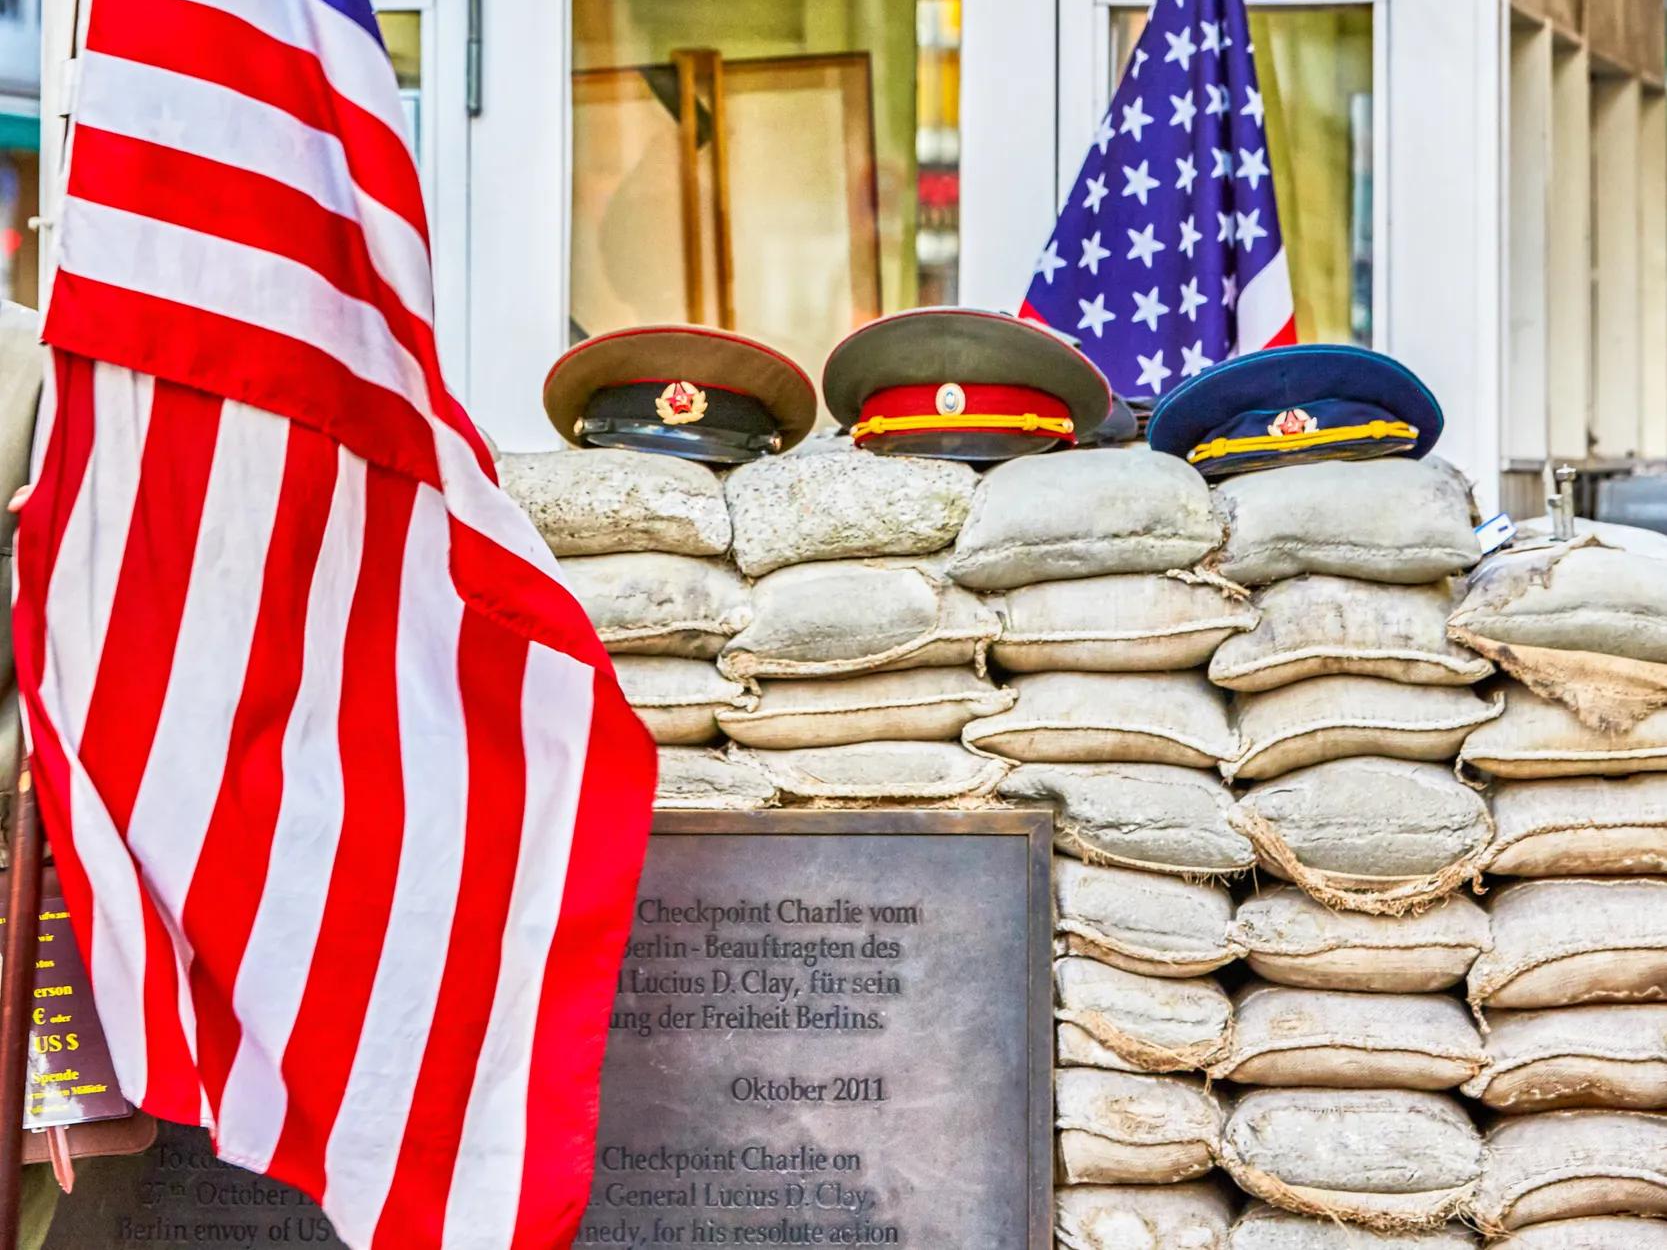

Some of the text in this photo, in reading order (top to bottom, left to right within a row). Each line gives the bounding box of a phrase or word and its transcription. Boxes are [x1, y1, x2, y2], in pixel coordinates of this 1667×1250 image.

[637, 899, 918, 931] Checkpoint Charlie vom
[861, 934, 901, 959] des
[33, 986, 73, 998] erson
[631, 969, 705, 994] Lucius
[712, 969, 736, 994] D.
[742, 969, 801, 1002] Clay,
[810, 970, 847, 994] für
[853, 971, 901, 994] sein
[658, 1005, 695, 1029] der
[702, 1005, 790, 1029] Freiheit
[796, 1005, 884, 1030] Berlins.
[731, 1077, 885, 1101] Oktober 2011
[602, 1146, 736, 1179] Checkpoint
[741, 1146, 828, 1171] Charlie
[833, 1154, 861, 1170] on
[197, 1181, 289, 1206] October
[605, 1182, 696, 1206] General
[704, 1182, 778, 1207] Lucius
[786, 1183, 810, 1207] D.
[816, 1182, 876, 1215] Clay,
[120, 1216, 187, 1241] Berlin
[194, 1224, 258, 1250] envoy
[269, 1216, 293, 1241] of
[298, 1218, 331, 1241] US
[652, 1218, 685, 1243] for
[692, 1218, 726, 1243] his
[734, 1218, 823, 1243] resolute
[829, 1219, 898, 1243] action
